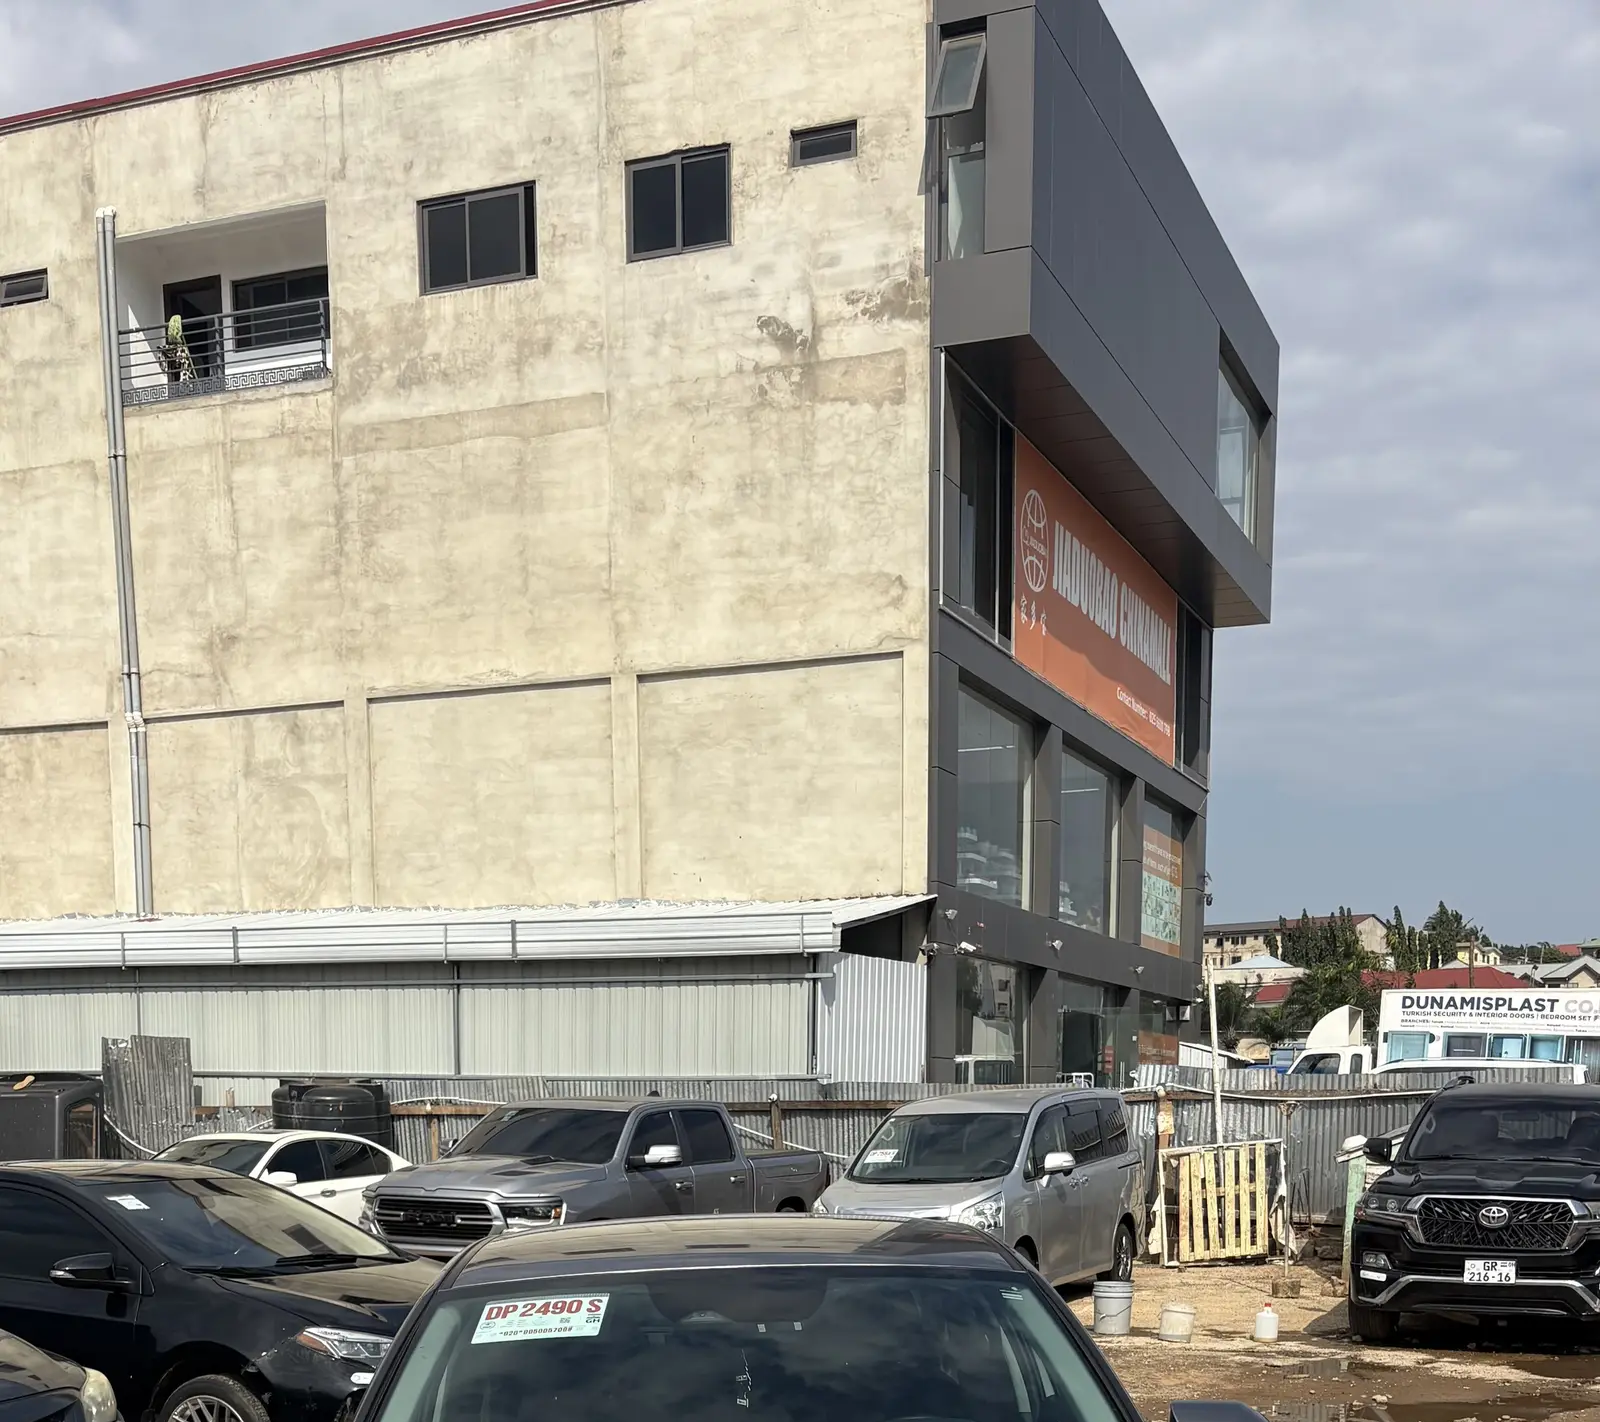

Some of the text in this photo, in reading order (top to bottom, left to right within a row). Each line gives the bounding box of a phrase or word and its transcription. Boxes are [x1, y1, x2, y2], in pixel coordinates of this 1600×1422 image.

[1053, 520, 1171, 686] JIADUOBAO CHINAMALL
[1401, 995, 1600, 1014] DUNAMISPLAST CO.
[1474, 1011, 1509, 1019] INTERIOR
[1509, 1012, 1535, 1020] DOORS
[1540, 1013, 1577, 1021] BEDROOM
[1577, 1014, 1592, 1022] SET
[1483, 1261, 1498, 1271] GR
[485, 1298, 603, 1321] DP 2490 S
